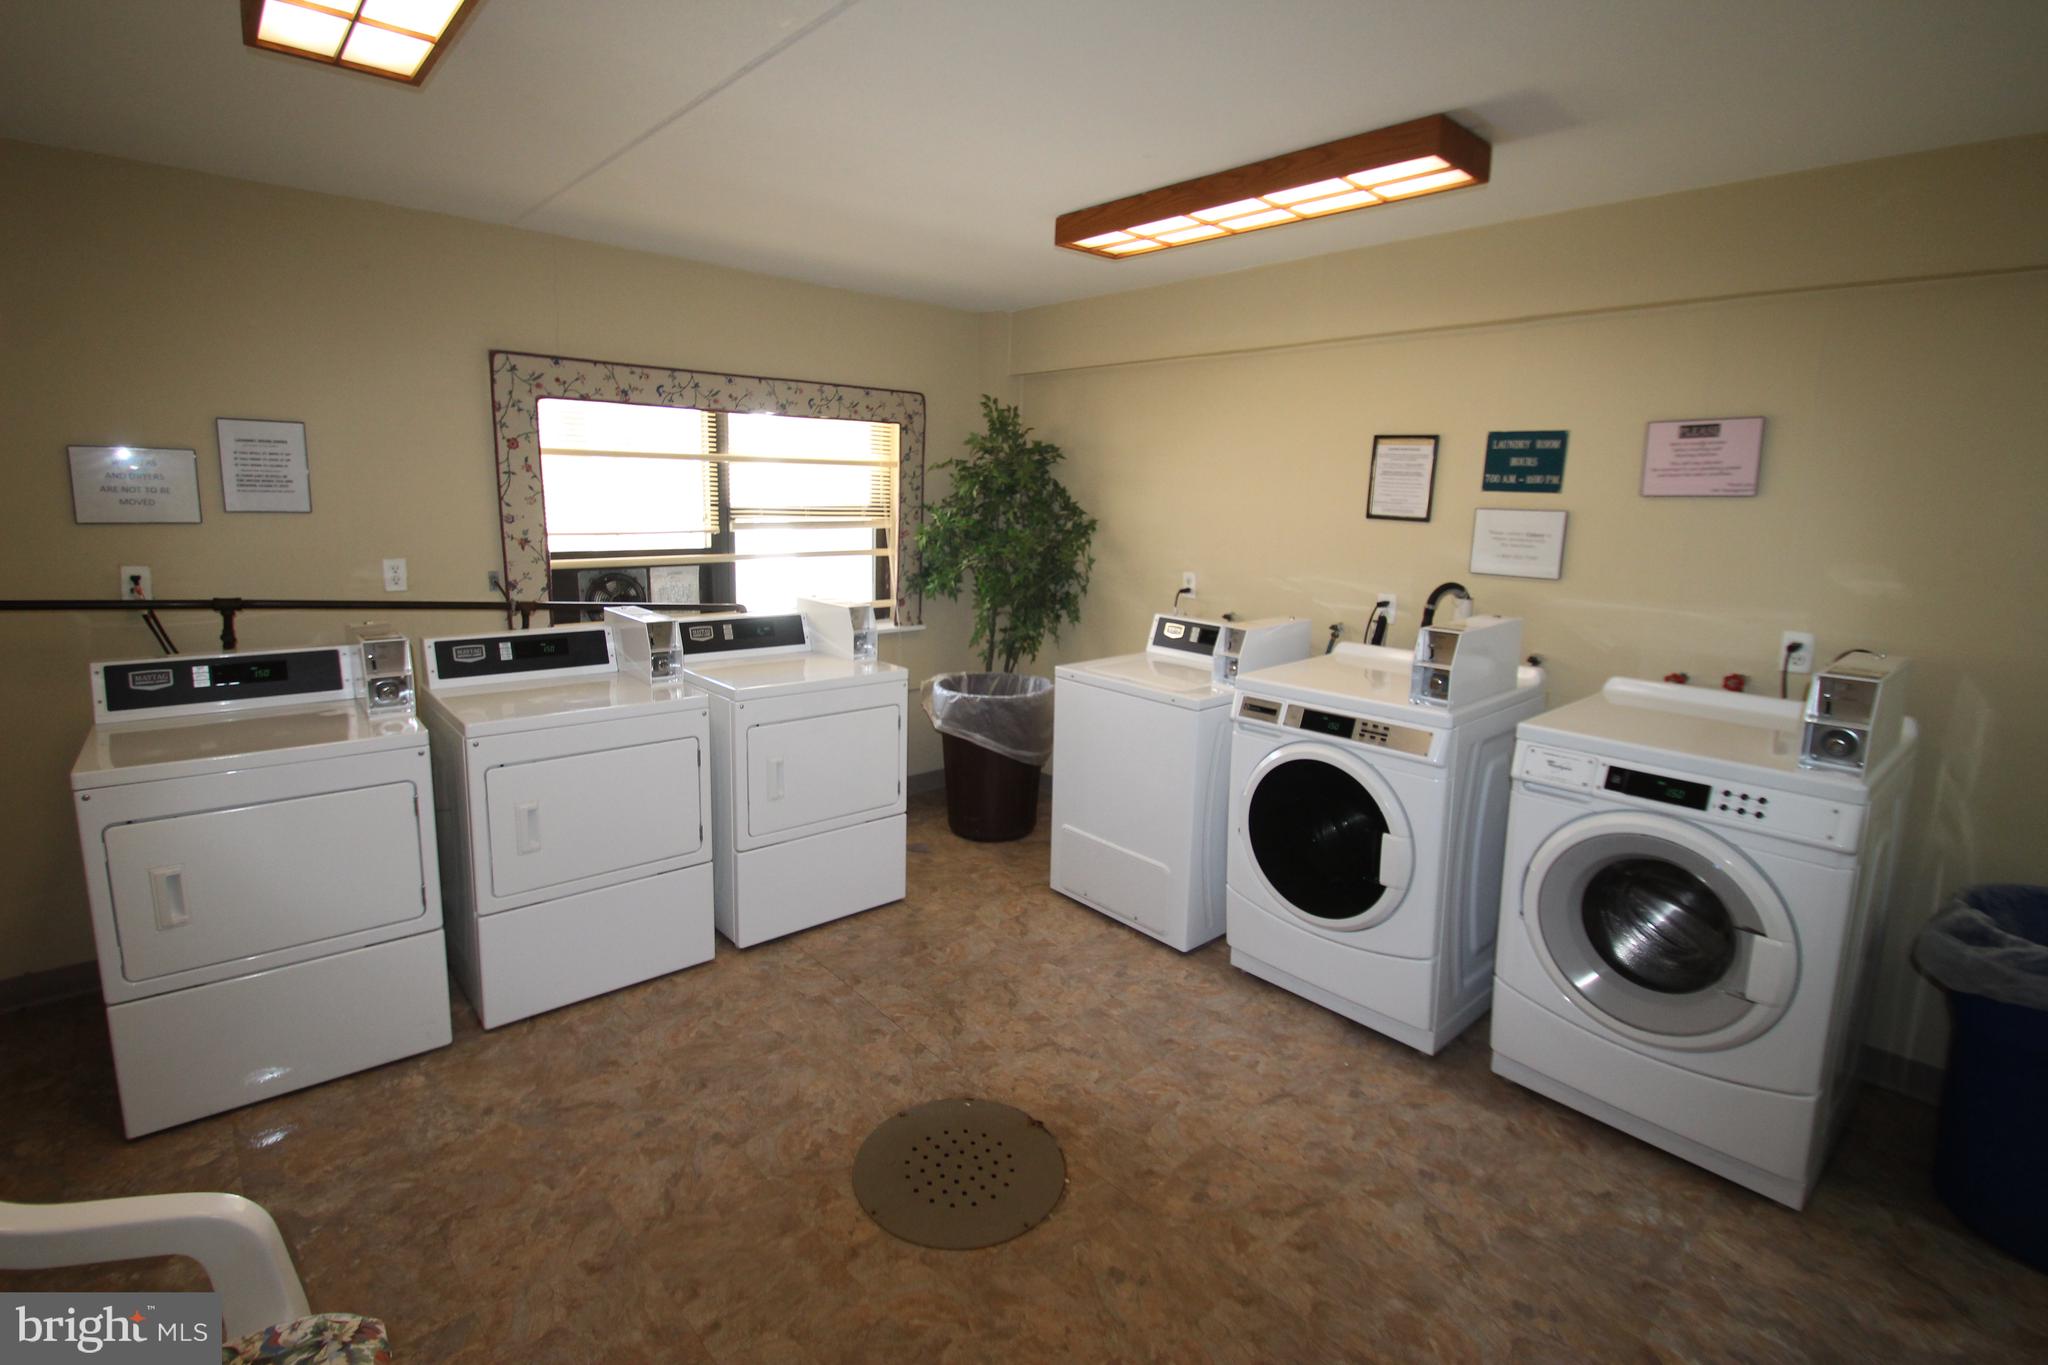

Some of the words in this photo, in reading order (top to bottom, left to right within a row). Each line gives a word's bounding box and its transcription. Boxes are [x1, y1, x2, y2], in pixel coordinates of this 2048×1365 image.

[104, 471, 127, 480] AND
[99, 485, 119, 493] ARE
[121, 486, 142, 494] NOT
[144, 486, 157, 494] TO
[160, 487, 171, 495] BE
[119, 498, 156, 506] MOVED
[135, 673, 169, 681] MAYTAG
